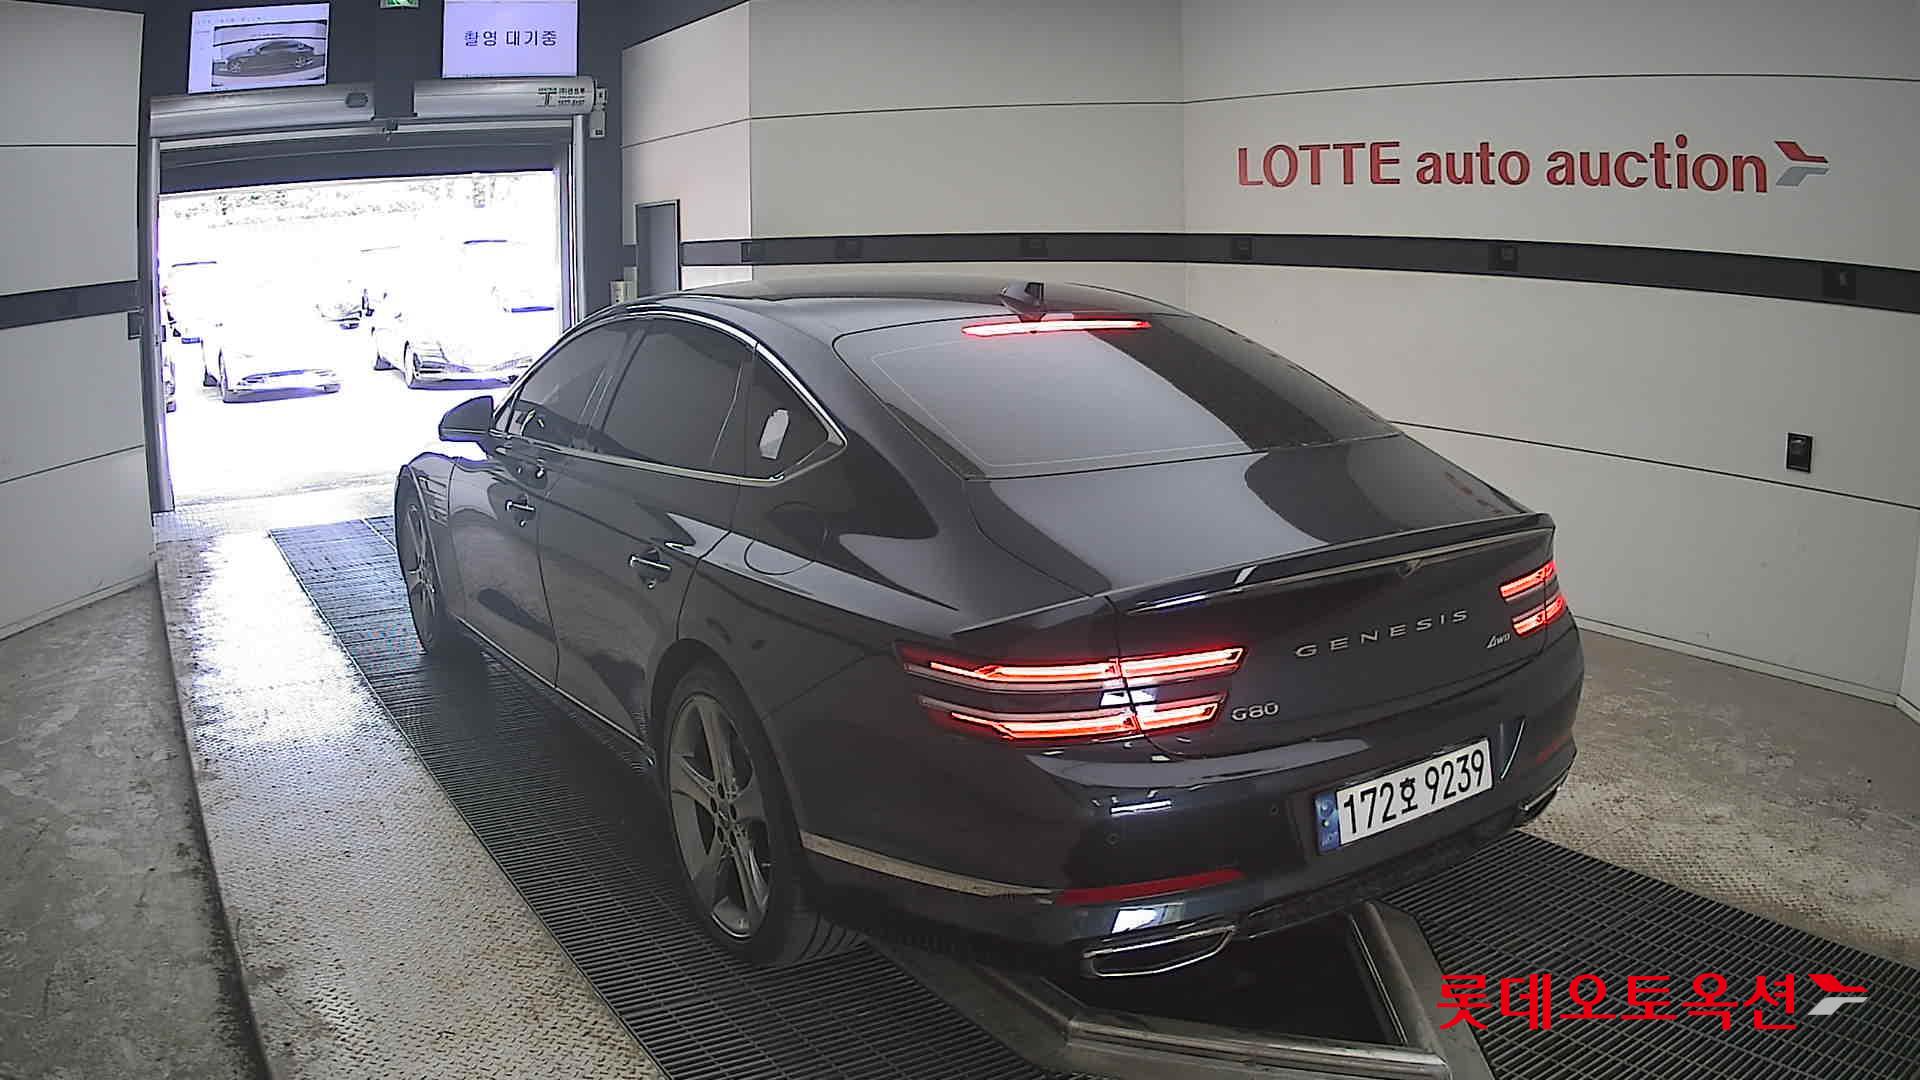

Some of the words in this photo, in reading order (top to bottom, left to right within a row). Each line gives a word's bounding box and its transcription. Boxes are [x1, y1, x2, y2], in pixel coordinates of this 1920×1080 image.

[506, 30, 557, 46] 대기중
[1238, 141, 1401, 188] LOTTE
[1416, 142, 1531, 187] auto
[1546, 135, 1768, 193] auction
[1295, 610, 1468, 657] GENESIS
[1231, 702, 1279, 721] G80
[1424, 749, 1485, 804] 9239
